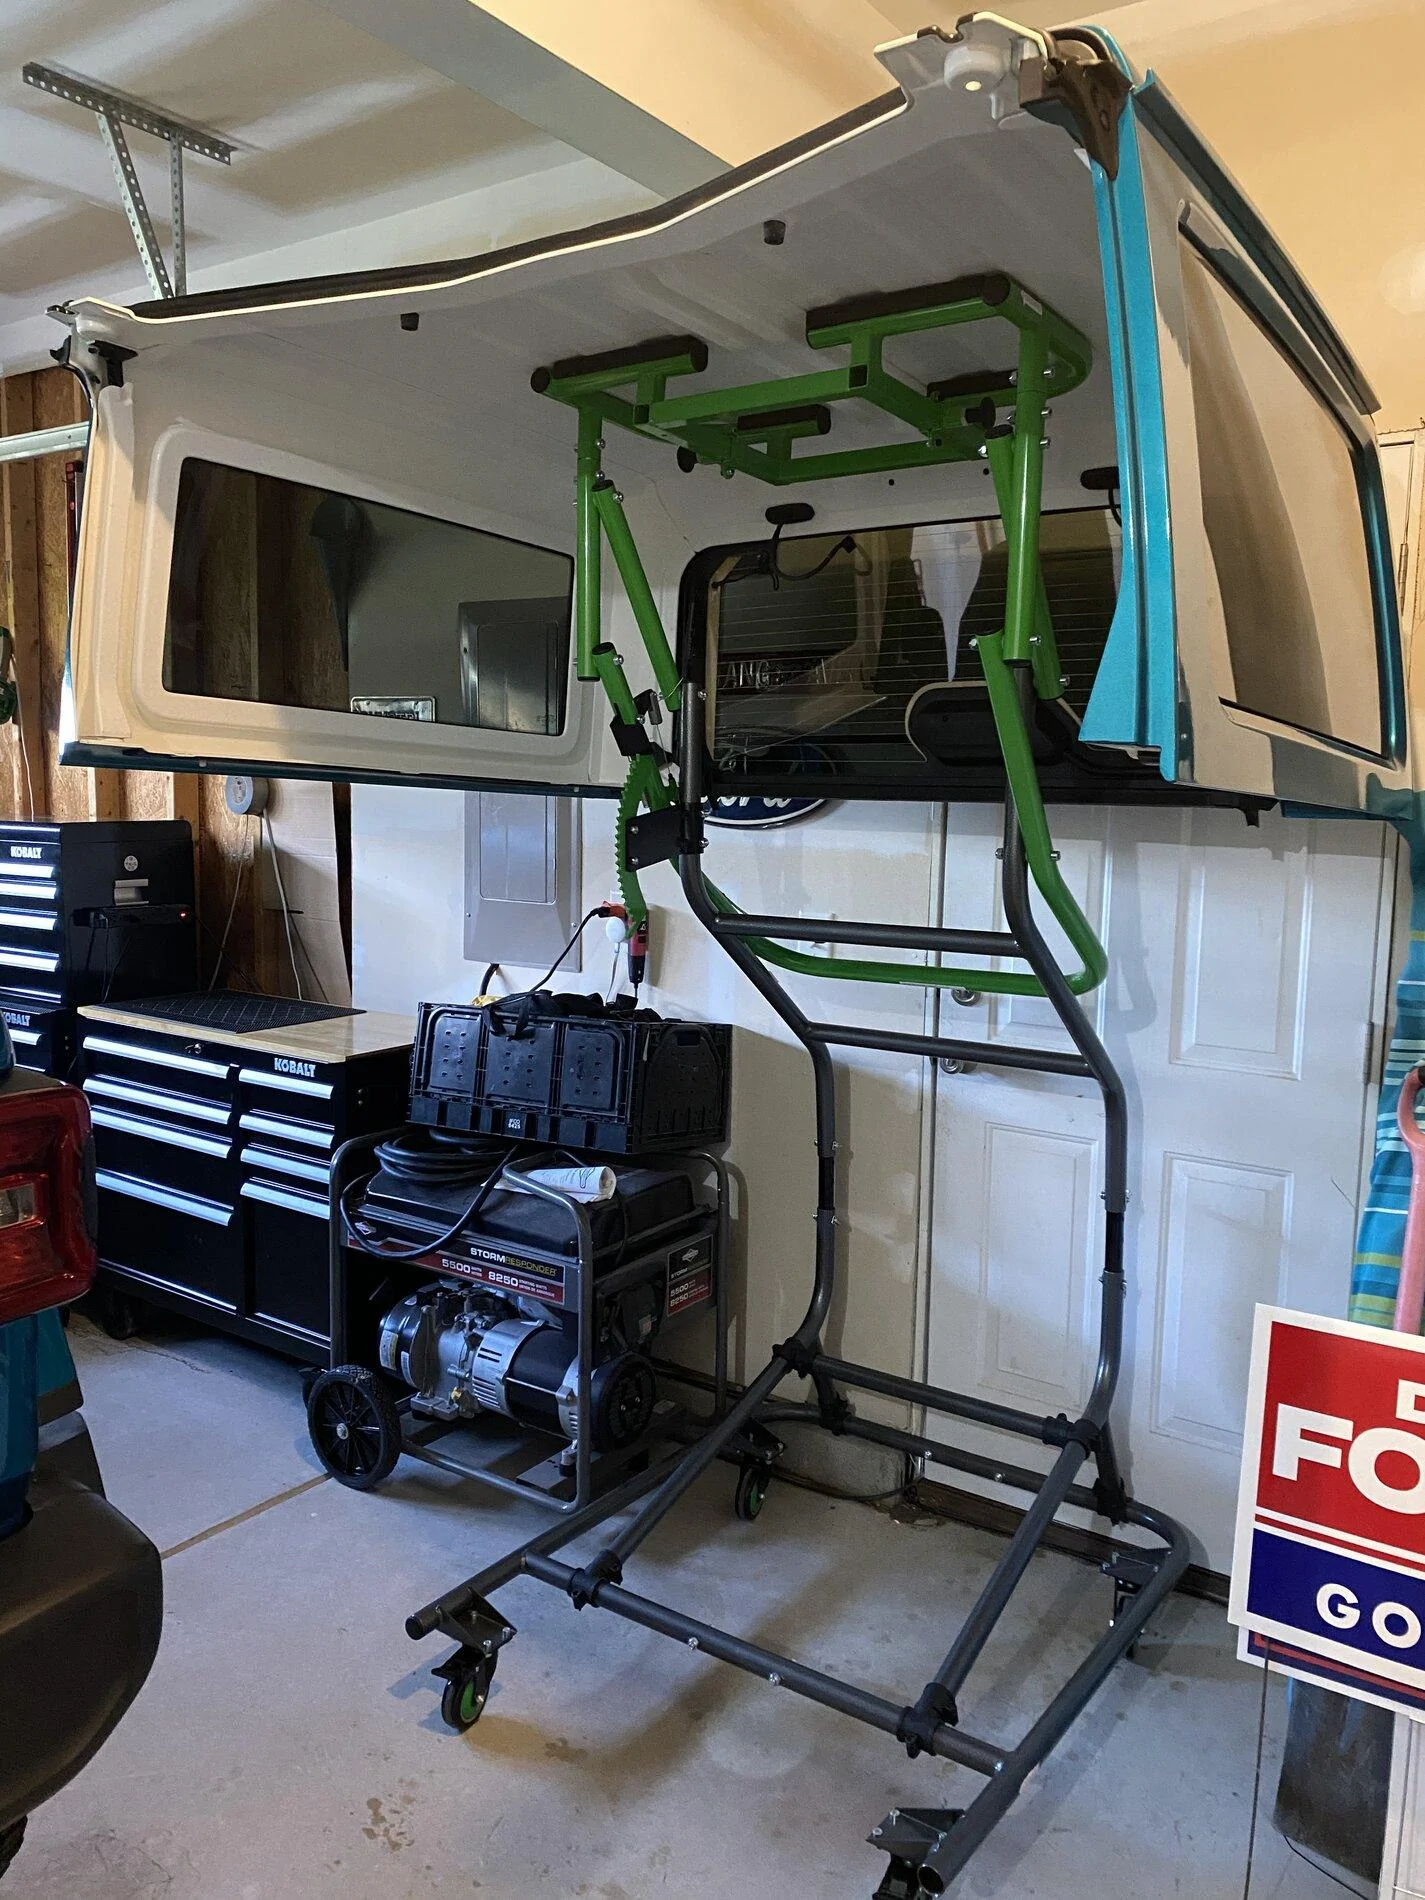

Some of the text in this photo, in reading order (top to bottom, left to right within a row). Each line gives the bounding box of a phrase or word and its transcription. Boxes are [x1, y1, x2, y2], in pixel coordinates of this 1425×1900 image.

[11, 846, 42, 859] KOBALT
[274, 1057, 316, 1078] KOBALT
[442, 1258, 471, 1274] 5500
[470, 1247, 557, 1276] STORMRESPONDER
[488, 1271, 519, 1287] 8250
[670, 1283, 689, 1297] 5500
[1272, 1402, 1425, 1515] FO
[1316, 1582, 1422, 1649] GO
